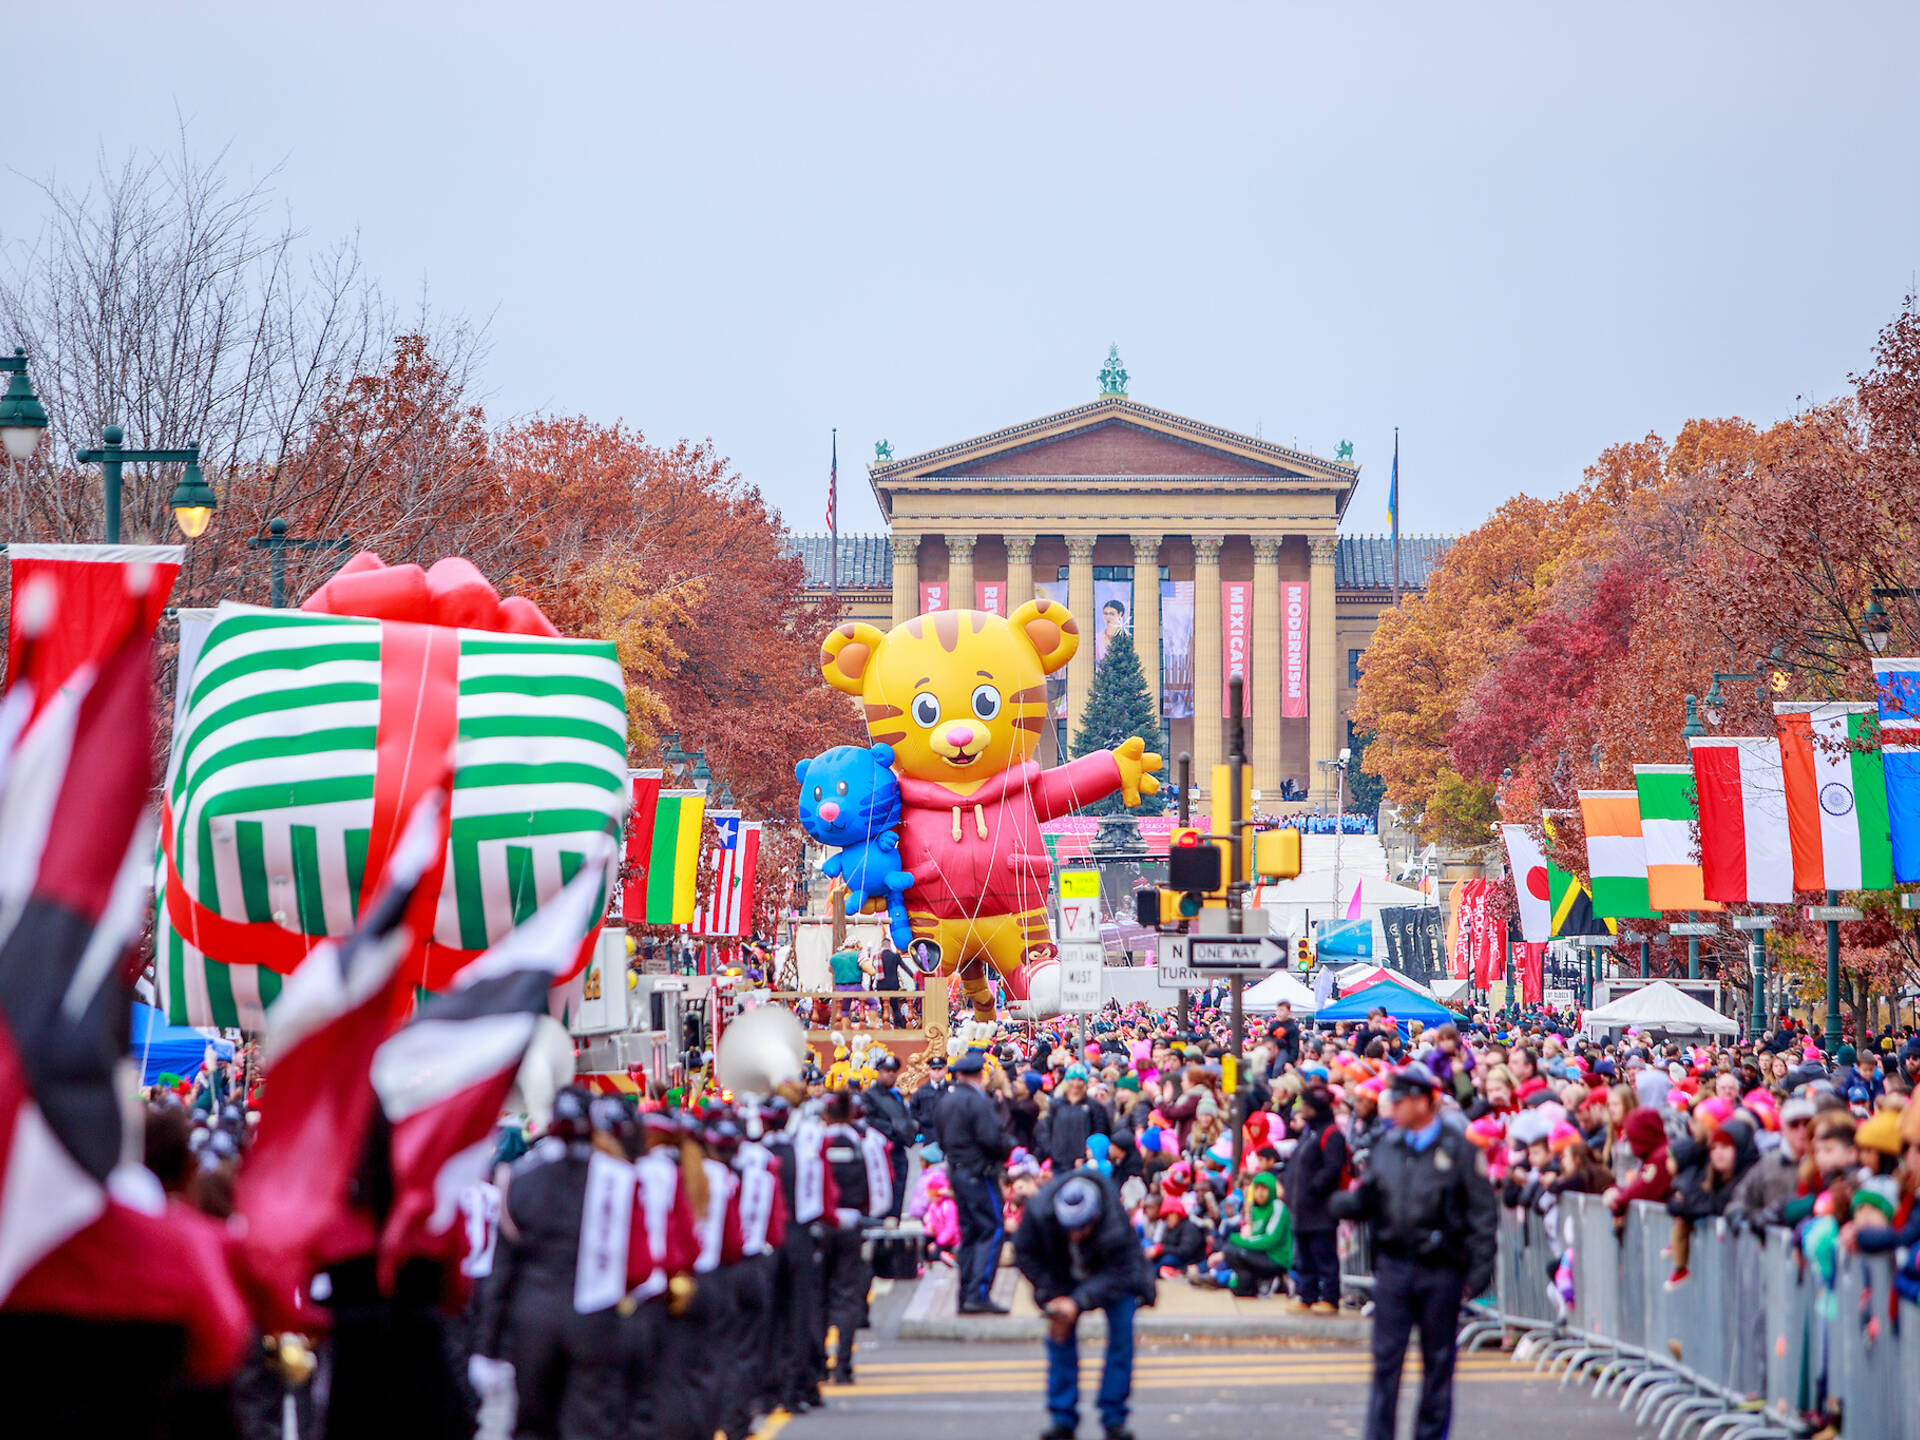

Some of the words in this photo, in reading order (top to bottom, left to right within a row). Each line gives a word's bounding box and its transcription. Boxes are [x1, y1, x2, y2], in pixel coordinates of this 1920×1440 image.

[1229, 586, 1244, 677] MEXICAN
[1287, 586, 1302, 698] MODERNISM
[1063, 951, 1079, 962] LEFT
[1080, 951, 1099, 962] LANE
[1197, 944, 1224, 959] ONE
[1231, 944, 1258, 959] WAY
[1430, 938, 1440, 971] RAM
[1069, 970, 1092, 984] MUST
[1063, 991, 1079, 1002] TURN
[1082, 991, 1099, 1002] LEFT
